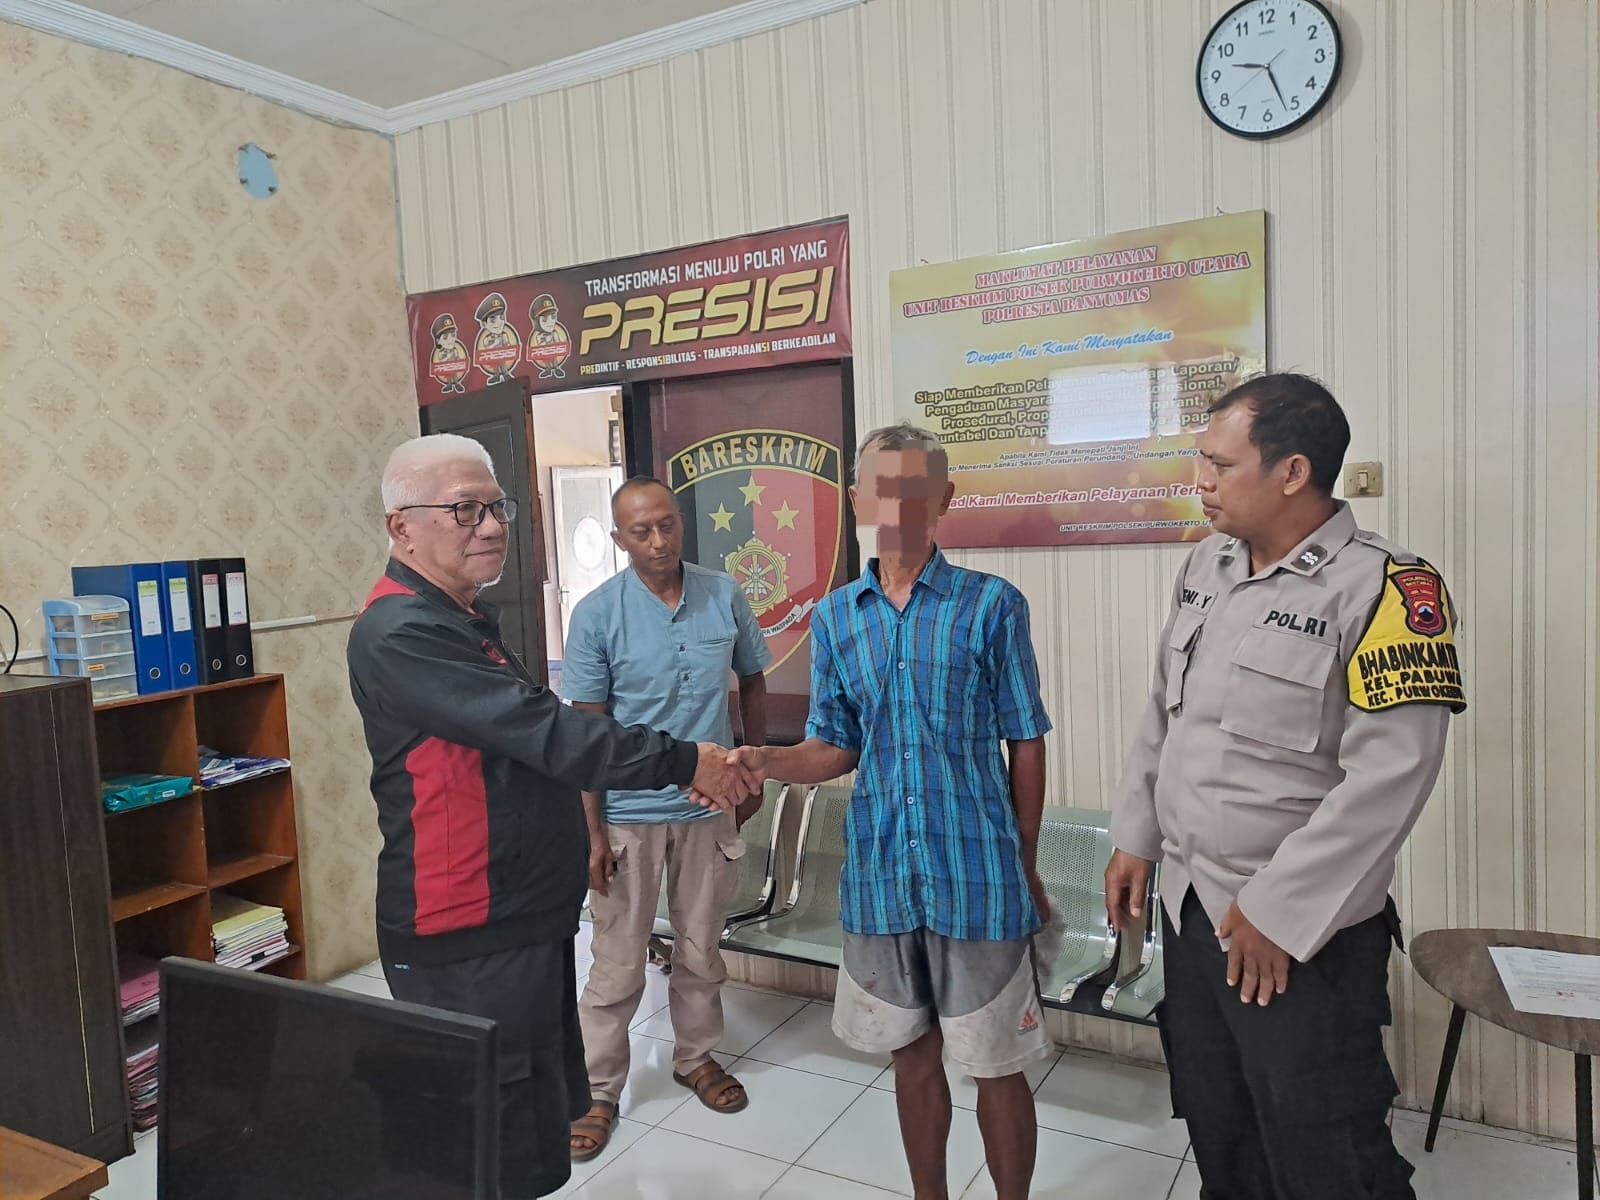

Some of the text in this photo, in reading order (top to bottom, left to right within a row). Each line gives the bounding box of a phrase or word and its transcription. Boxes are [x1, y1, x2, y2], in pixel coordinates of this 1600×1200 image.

[1258, 9, 1275, 25] 12
[1289, 11, 1296, 26] 1
[1235, 21, 1249, 37] 11
[1307, 25, 1318, 40] 2
[1217, 43, 1234, 58] 10
[1314, 48, 1326, 63] 3
[1211, 70, 1221, 84] 9
[1305, 75, 1317, 90] 4
[1219, 93, 1230, 107] 8
[1290, 96, 1300, 110] 5
[1238, 105, 1247, 120] 7
[1262, 108, 1273, 122] 6
[585, 239, 828, 297] TRANSFORMASI MENUJU POLRI YANG
[975, 246, 1158, 289] MAKLUMAT PELAYANAN
[903, 252, 1251, 317] UNIT RESKRIM POLSEK PURWOKERTO UTARA
[580, 266, 834, 356] PRESISI
[982, 287, 1151, 325] POLRESTA BANYUMAS
[580, 361, 620, 376] PREDIKTIF
[626, 351, 696, 370] RESPONSIBILITAS
[703, 342, 770, 360] TRANSPARANSI
[771, 332, 836, 352] BERKEADILAN
[966, 329, 1172, 365] Dengan Ini Kami Menyatakan
[914, 390, 943, 405] Siap
[945, 382, 1024, 401] Memberikan
[925, 402, 995, 418] Pengaduan
[941, 413, 1015, 430] Prosedural,
[938, 428, 985, 445] untabel
[988, 426, 1014, 441] Dan
[679, 435, 828, 481] BARESKRIM
[967, 494, 1001, 507] Kami
[1004, 488, 1087, 505] Memberikan
[1090, 485, 1166, 503] Pelayanan
[1170, 484, 1203, 497] Terb
[1263, 610, 1327, 637] POLRI
